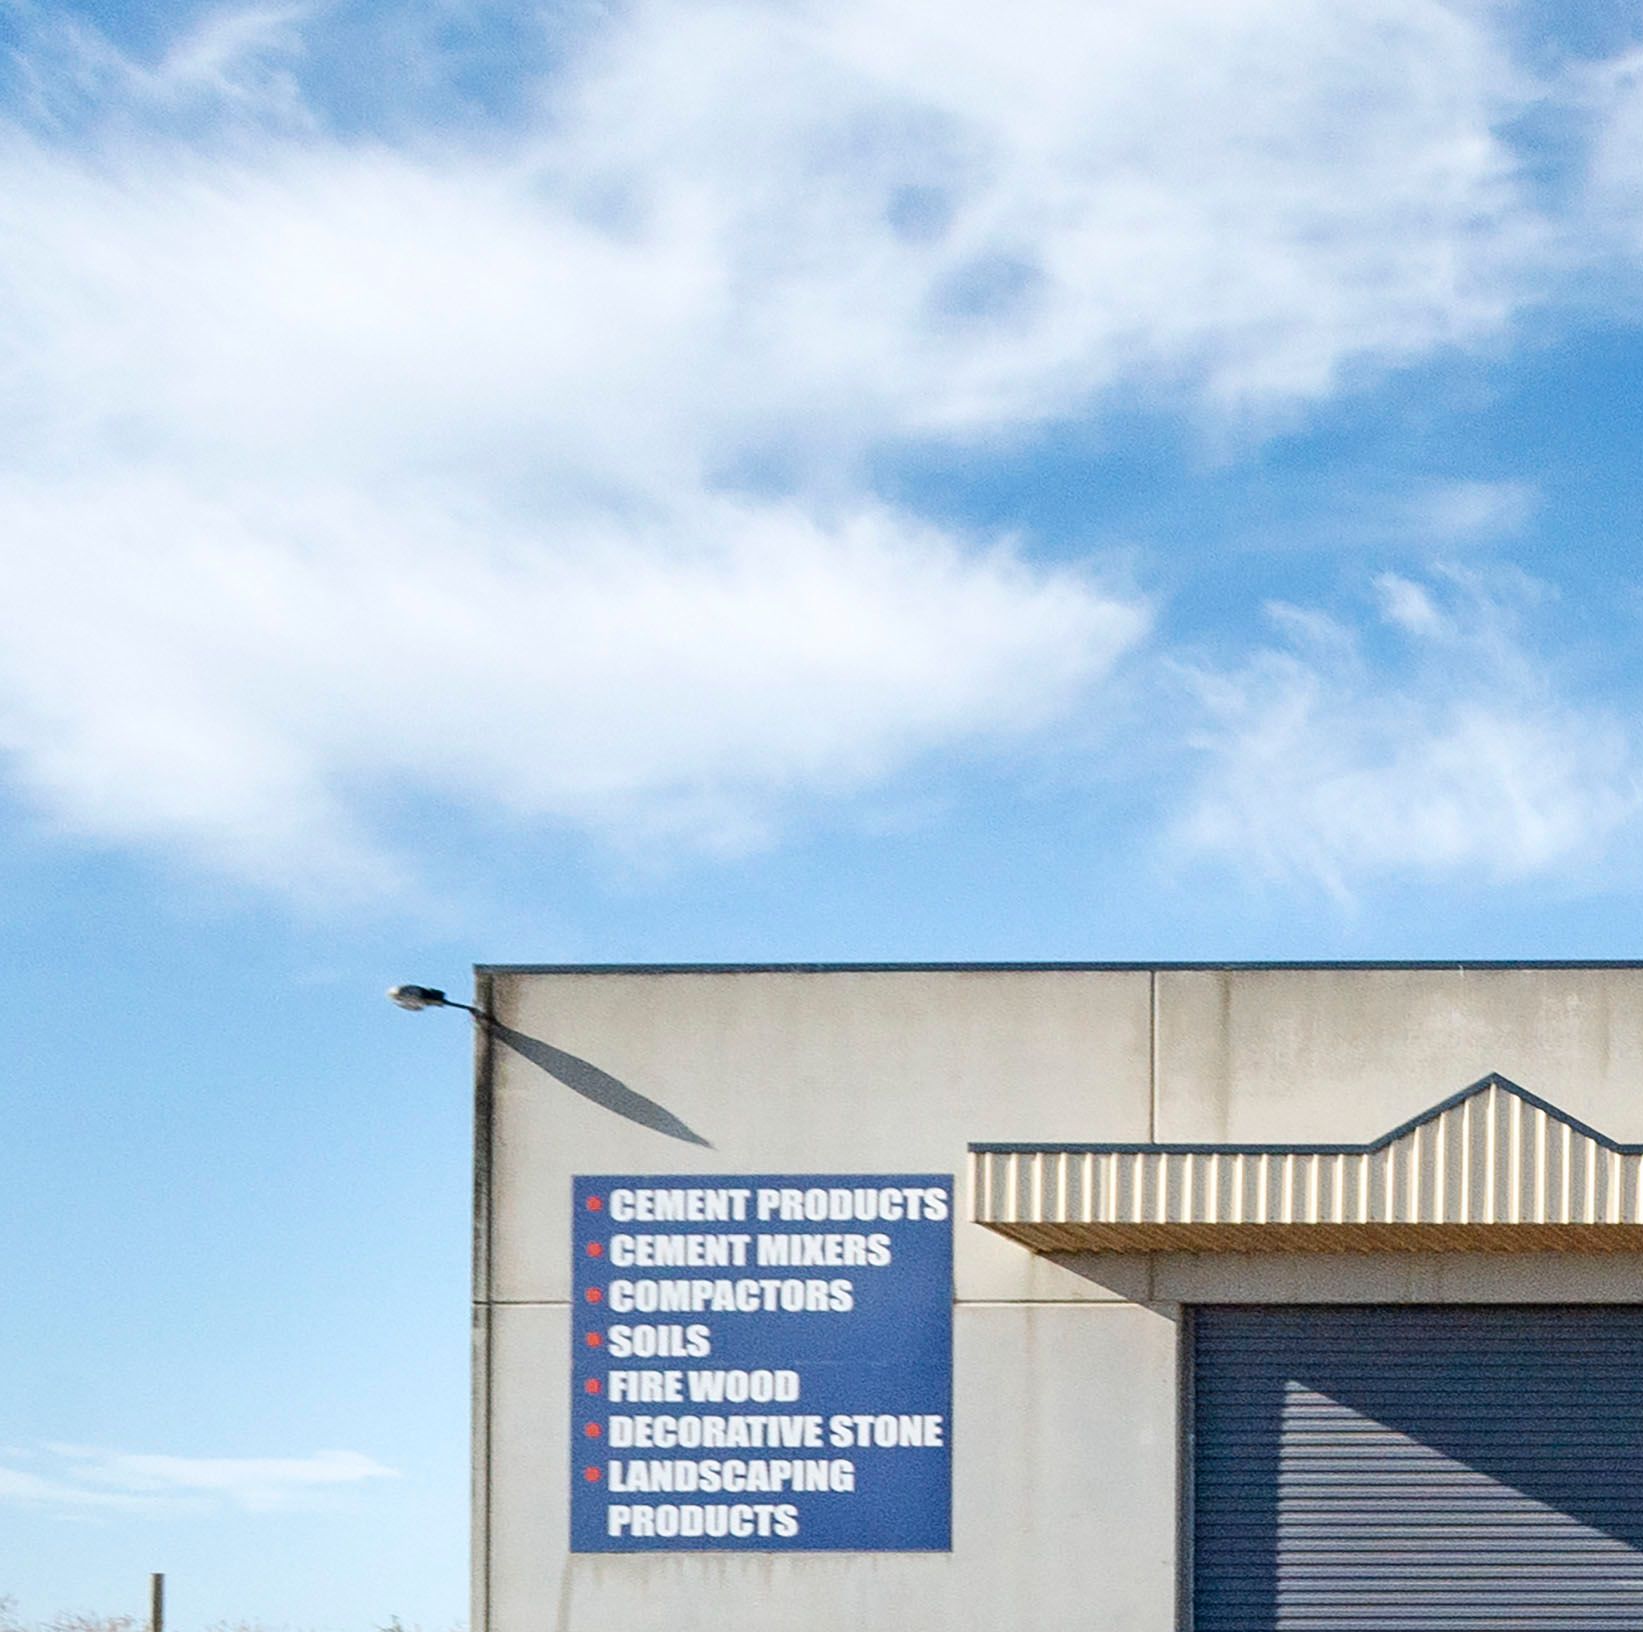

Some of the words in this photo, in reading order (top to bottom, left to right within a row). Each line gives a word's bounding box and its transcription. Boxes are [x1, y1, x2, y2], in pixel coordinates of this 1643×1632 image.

[609, 1189, 750, 1222] CEMENT
[757, 1188, 949, 1222] PRODUCTS
[609, 1235, 750, 1268] CEMENT
[757, 1234, 892, 1267] MIXERS
[609, 1280, 854, 1313] COMPACTORS
[609, 1325, 711, 1358] SOILS
[609, 1371, 682, 1403] FIRE
[689, 1370, 800, 1403] WOOD
[608, 1415, 825, 1448] DECORATIVE
[829, 1415, 944, 1448] STONE
[608, 1460, 856, 1493] LANDSCAPING
[608, 1505, 799, 1538] PRODUCTS
